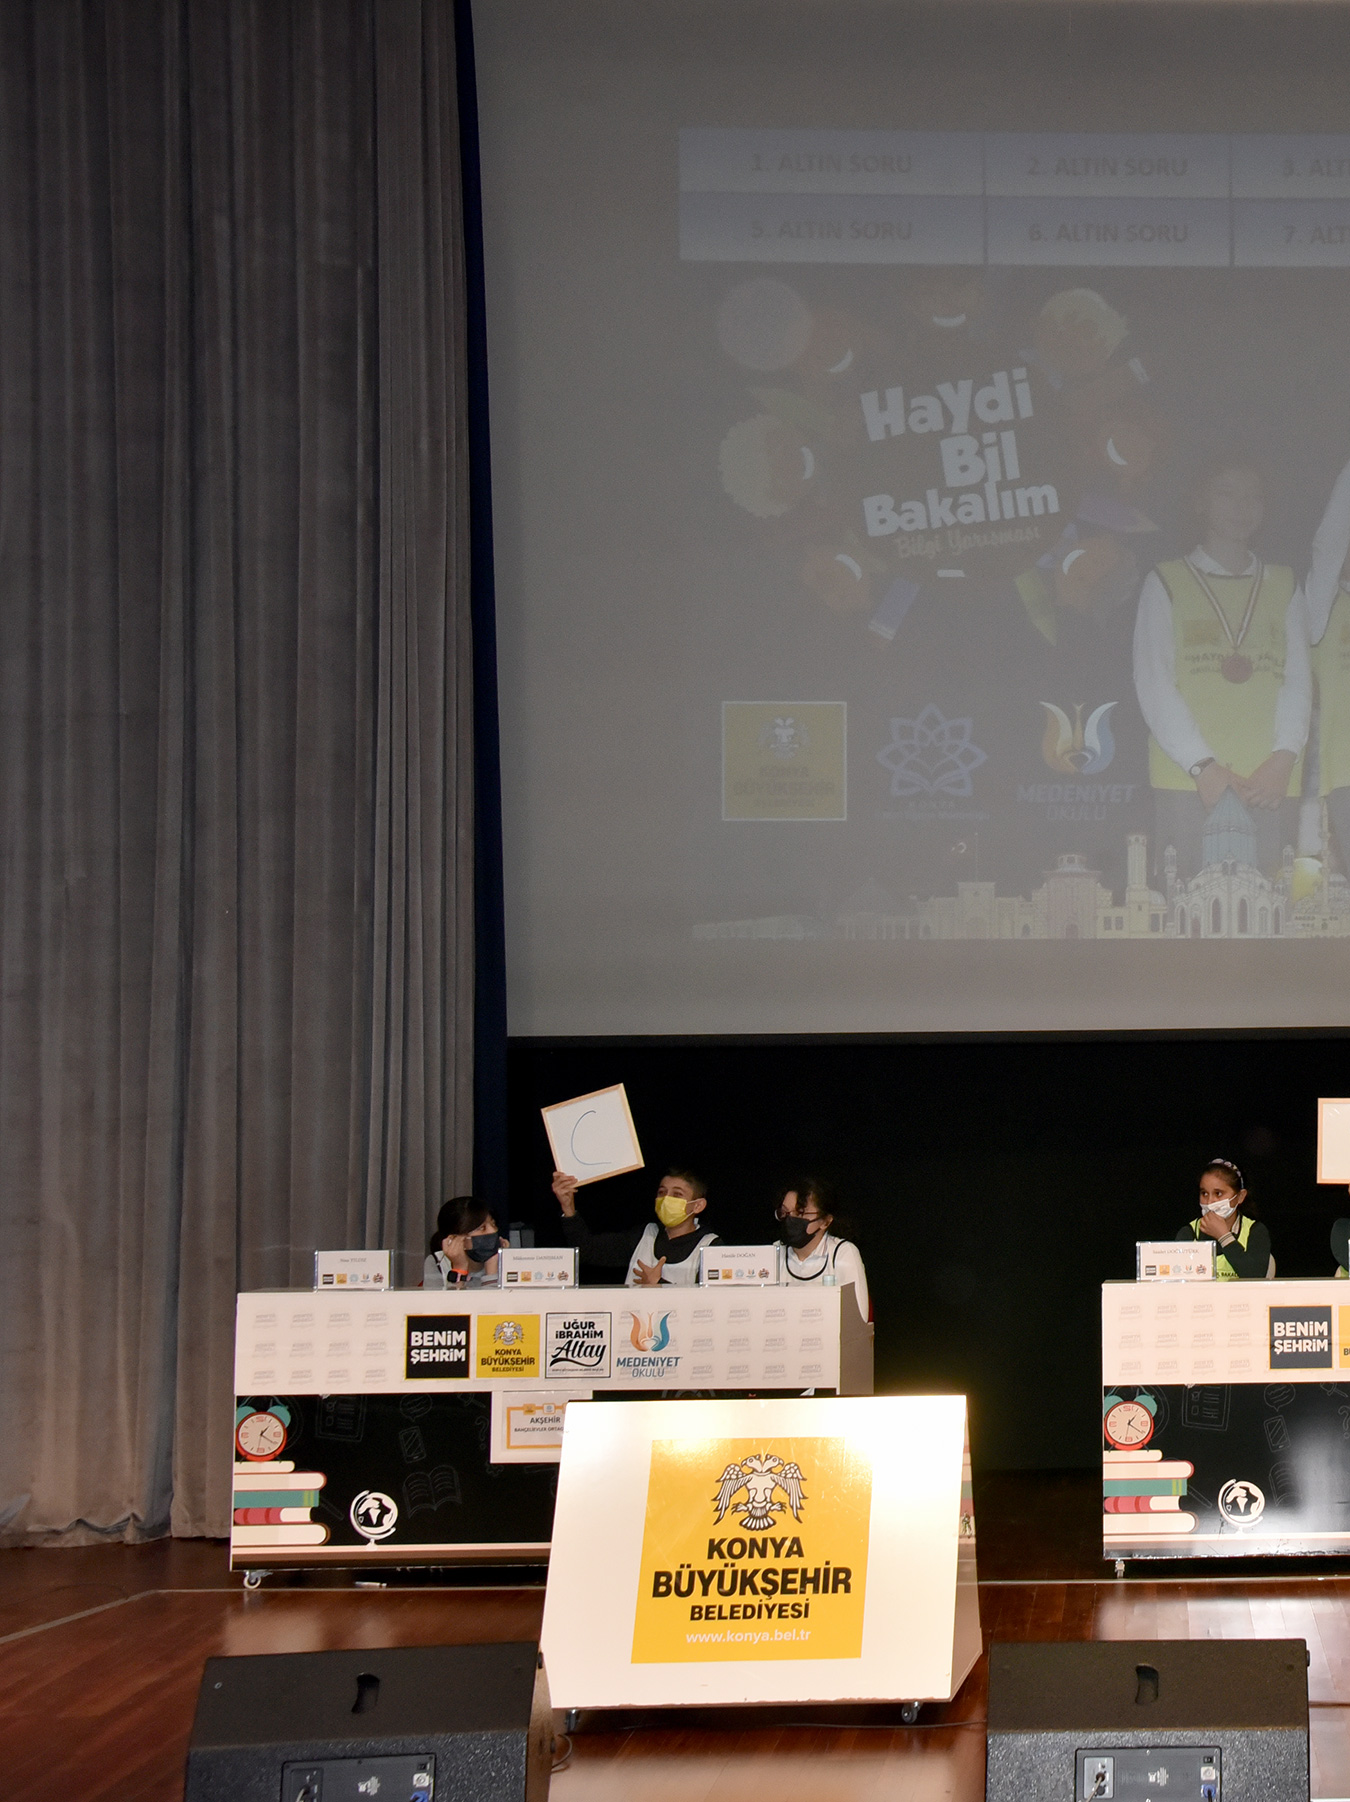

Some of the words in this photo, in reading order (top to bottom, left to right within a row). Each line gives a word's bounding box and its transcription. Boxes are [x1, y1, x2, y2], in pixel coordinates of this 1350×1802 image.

[777, 155, 842, 174] ALTIN
[848, 154, 913, 175] SORU
[1054, 158, 1119, 177] ALTIN
[1125, 158, 1188, 177] SORU
[778, 220, 842, 241] ALTIN
[848, 220, 913, 241] SORU
[1056, 223, 1119, 243] ALTIN
[1126, 223, 1188, 243] SORU
[860, 367, 1034, 442] Haydi
[940, 430, 1020, 488] Bil
[862, 481, 1060, 537] Bakalım
[571, 1110, 612, 1166] C
[563, 1319, 596, 1331] UĞUR
[494, 1348, 522, 1356] KONYA
[551, 1339, 607, 1366] Altay
[632, 1367, 665, 1378] OKULU
[529, 1415, 561, 1425] AKŞEHİR
[707, 1536, 804, 1560] KONYA
[652, 1560, 852, 1599] BÜYÜKŞEHİR
[689, 1598, 810, 1622] BELEDİYESİ
[686, 1629, 811, 1646] www.konya.bel.tr
